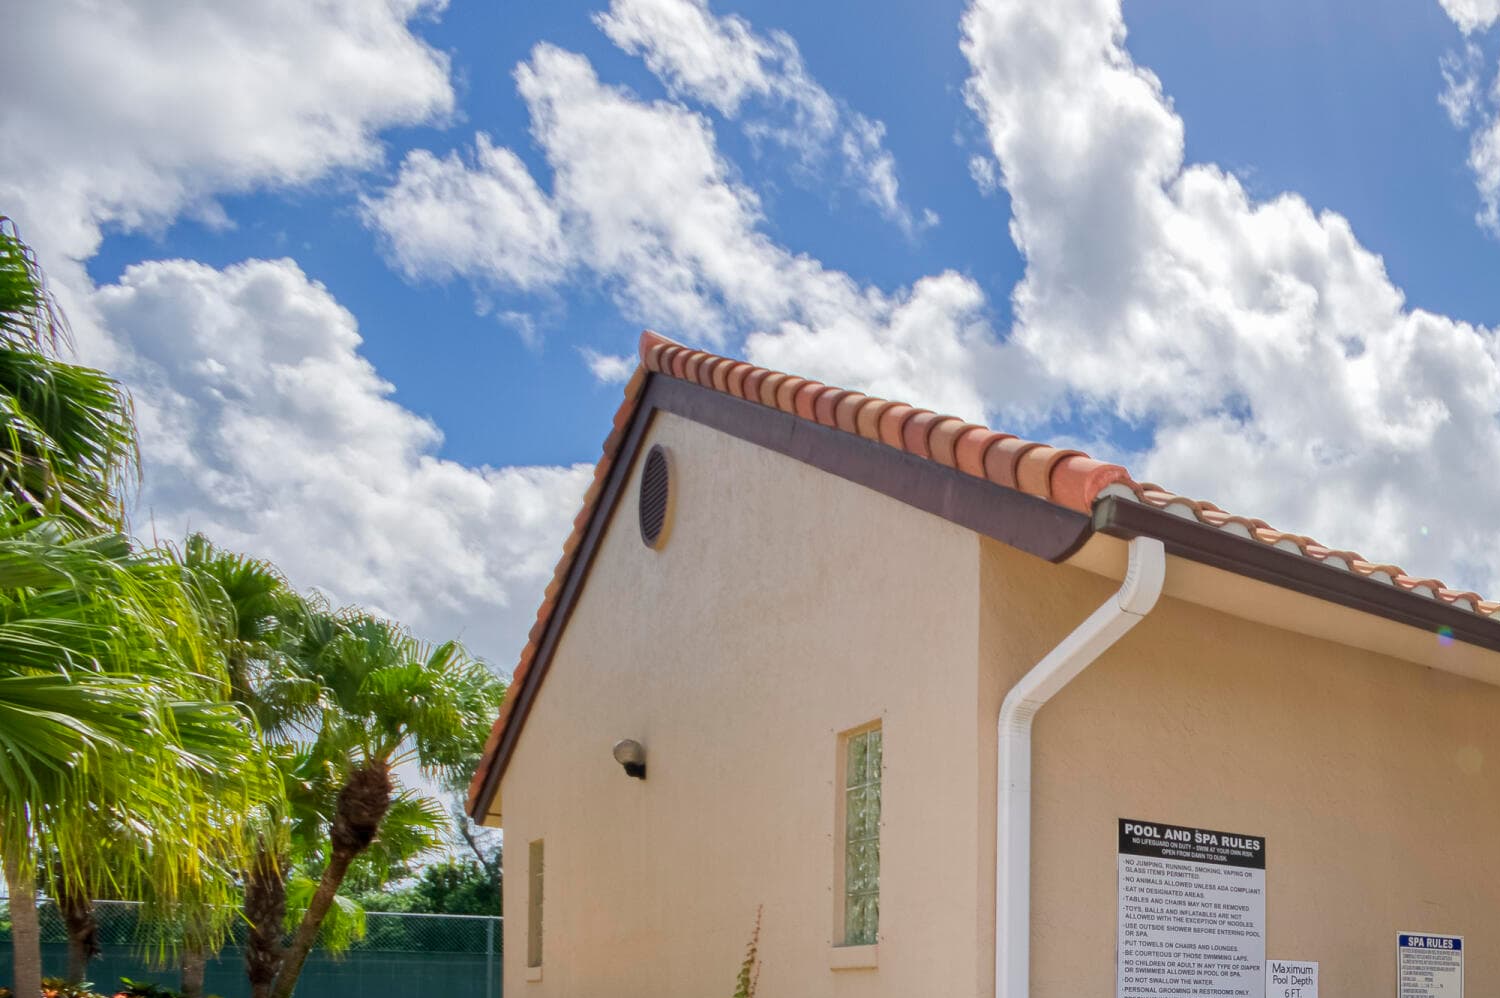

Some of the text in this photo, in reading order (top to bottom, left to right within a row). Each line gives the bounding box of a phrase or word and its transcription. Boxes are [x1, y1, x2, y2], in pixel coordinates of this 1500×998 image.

[1125, 823, 1260, 851] POOL AND SPA RULES
[1146, 888, 1183, 896] DESIGNATED
[1408, 937, 1453, 948] SPA RULES
[1272, 962, 1313, 974] Maximum
[1272, 974, 1313, 987] Pool Depth
[1285, 988, 1302, 998] 6 FT.
